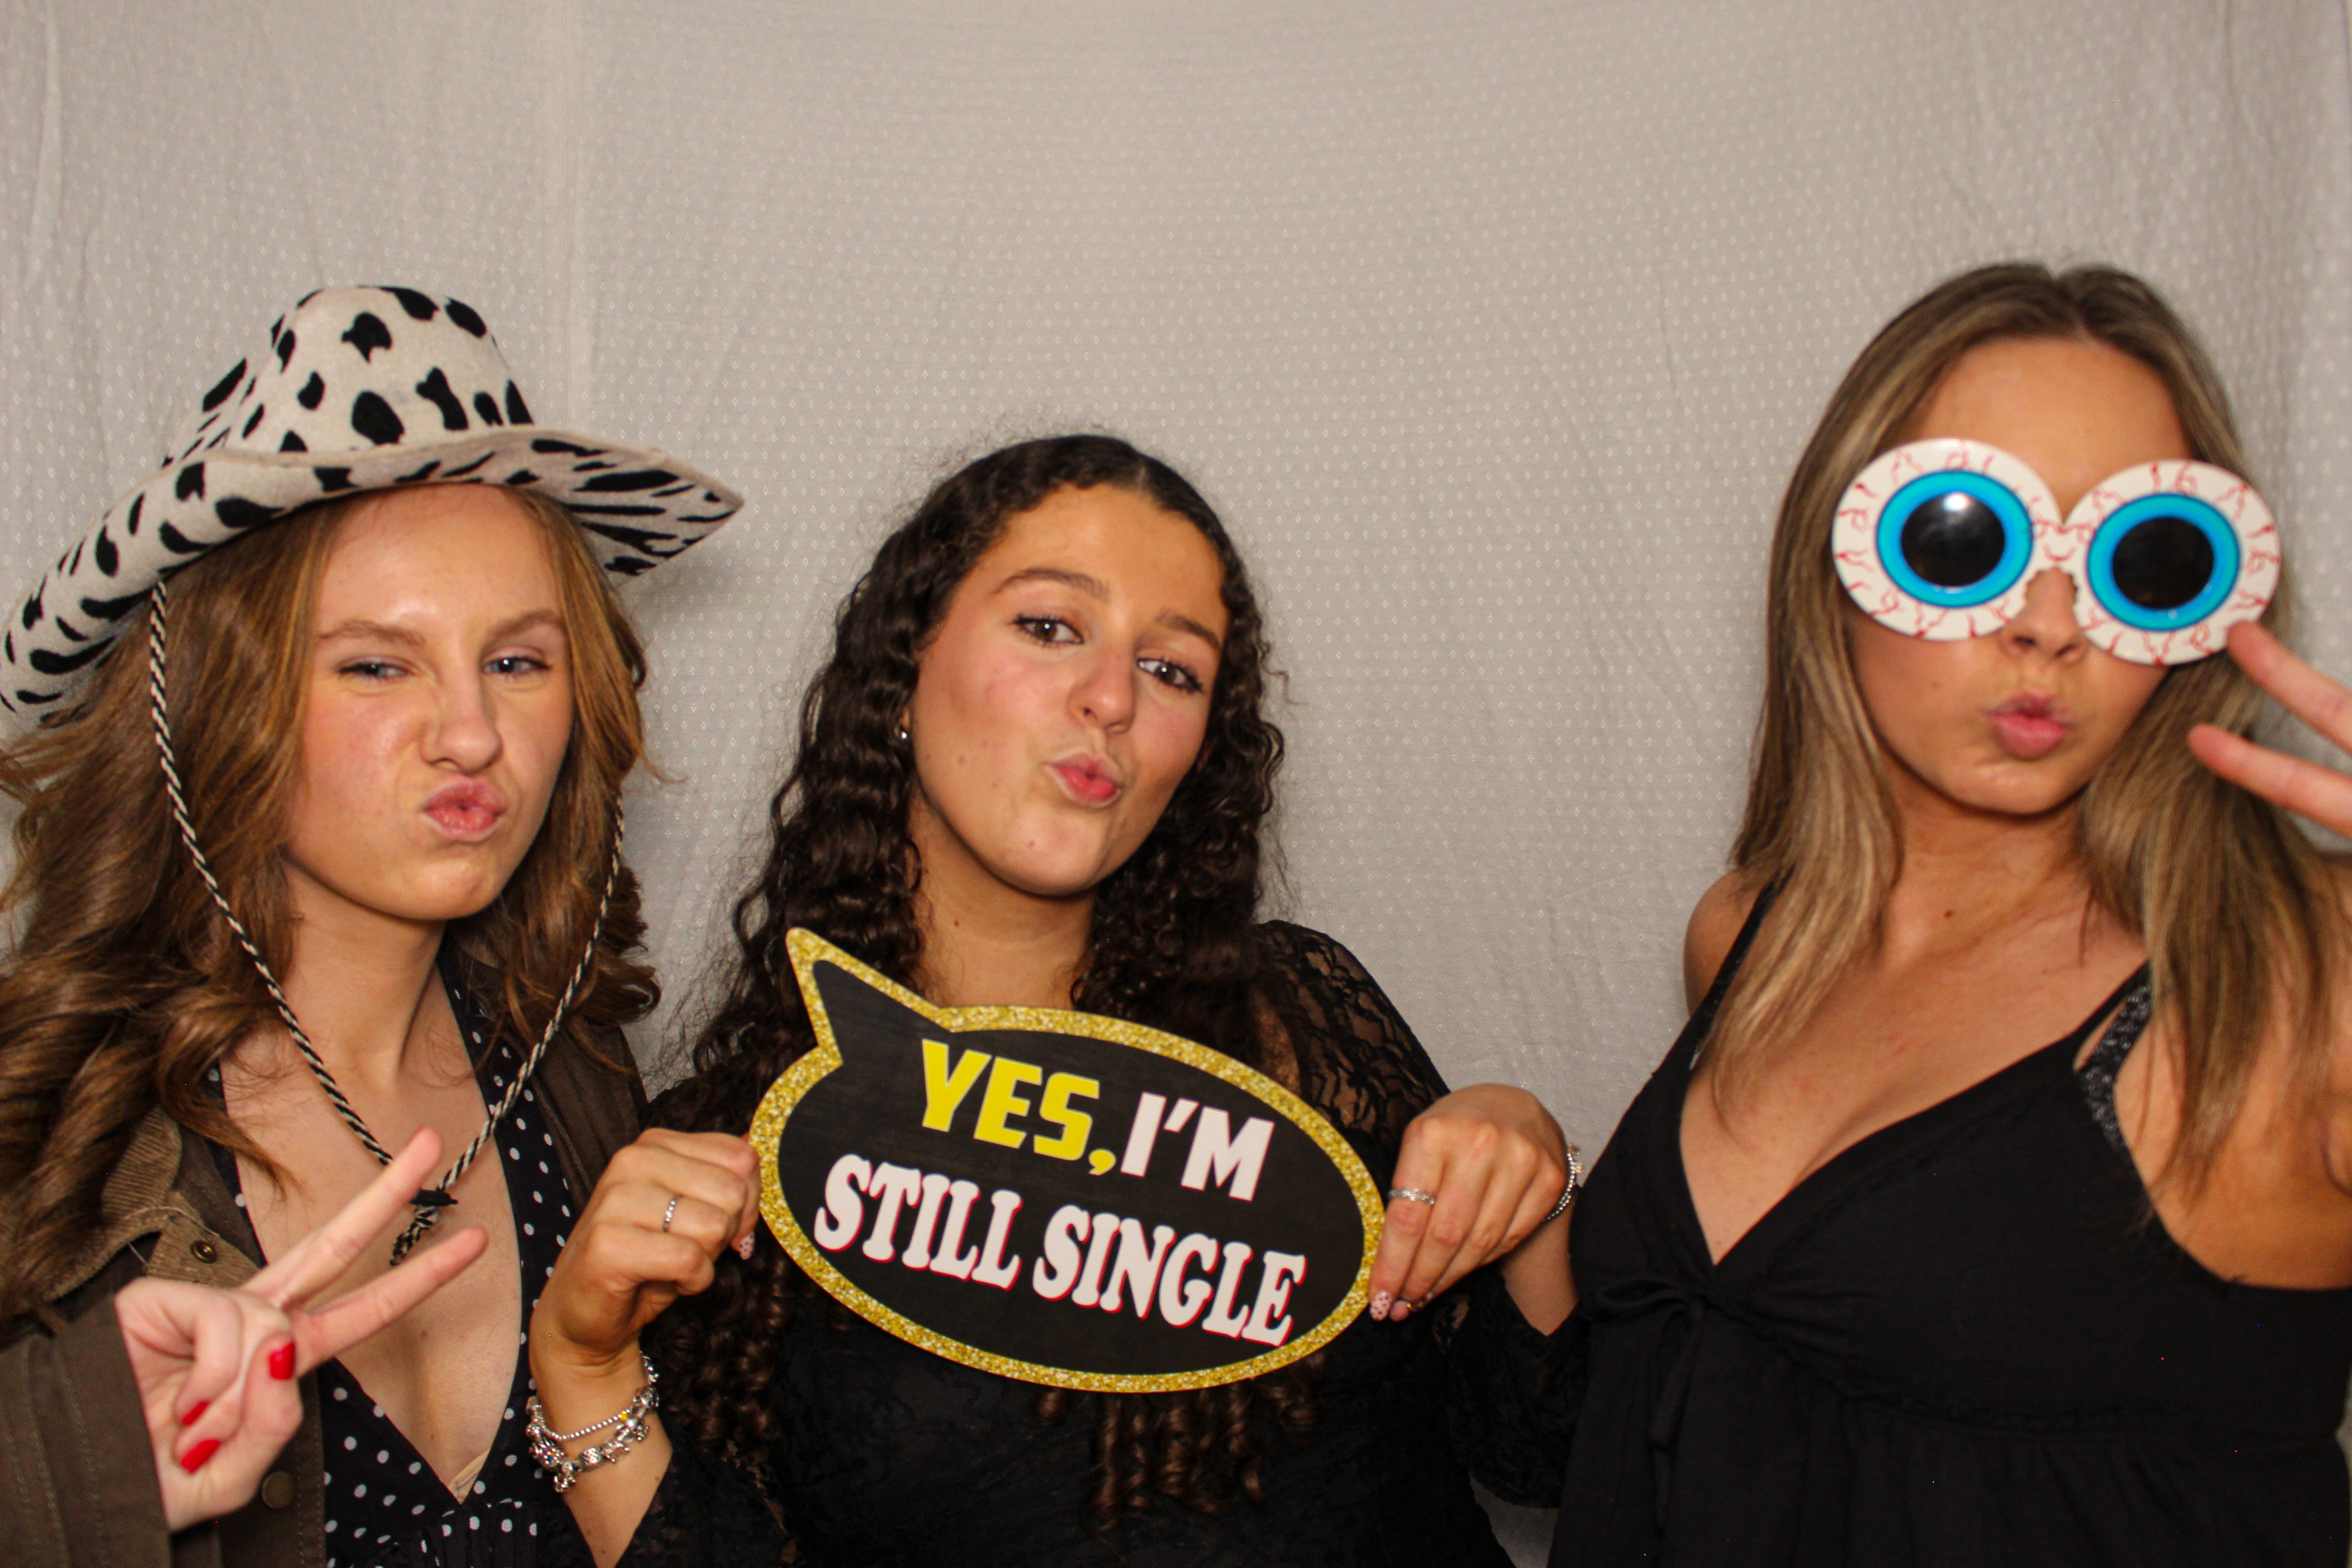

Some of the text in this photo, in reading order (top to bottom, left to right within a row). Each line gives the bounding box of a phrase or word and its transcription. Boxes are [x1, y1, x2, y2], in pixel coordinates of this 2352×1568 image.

[921, 1039, 1274, 1201] YES, I'M
[814, 1154, 1305, 1346] STILL SINGLE
